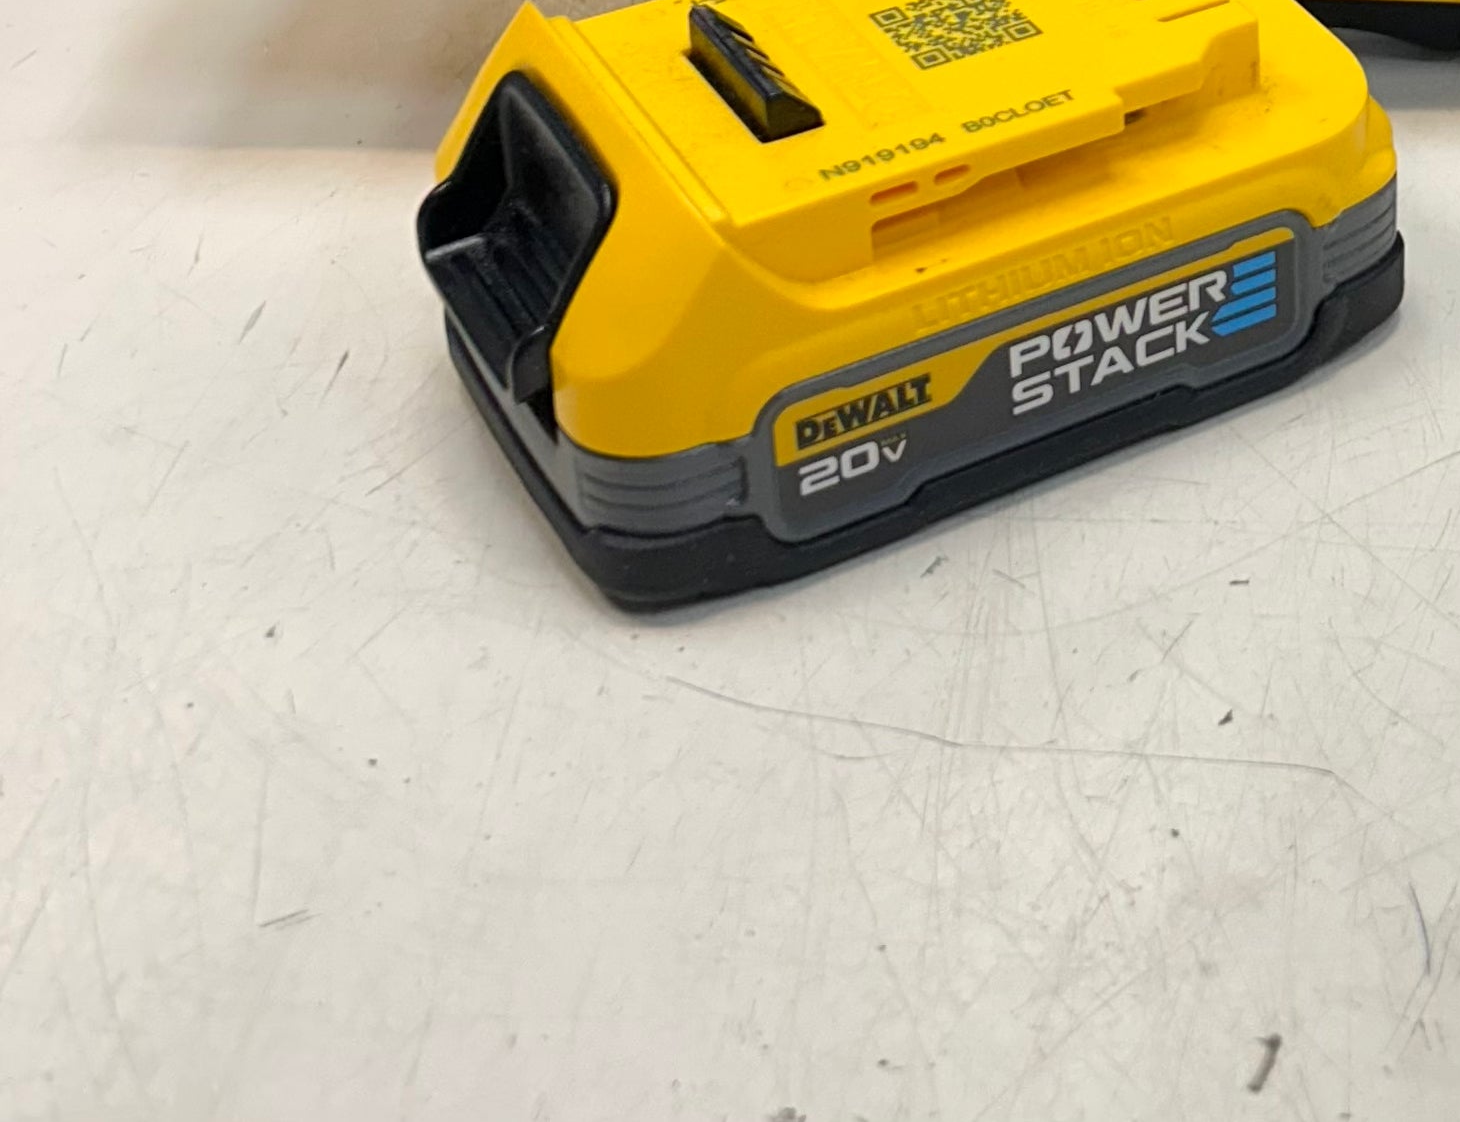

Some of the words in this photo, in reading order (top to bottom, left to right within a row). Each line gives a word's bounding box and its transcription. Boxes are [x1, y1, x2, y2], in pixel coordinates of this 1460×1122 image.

[818, 132, 946, 181] N919194
[1009, 270, 1228, 378] POWER
[1011, 310, 1211, 416] STACK
[796, 373, 932, 451] DEWALT
